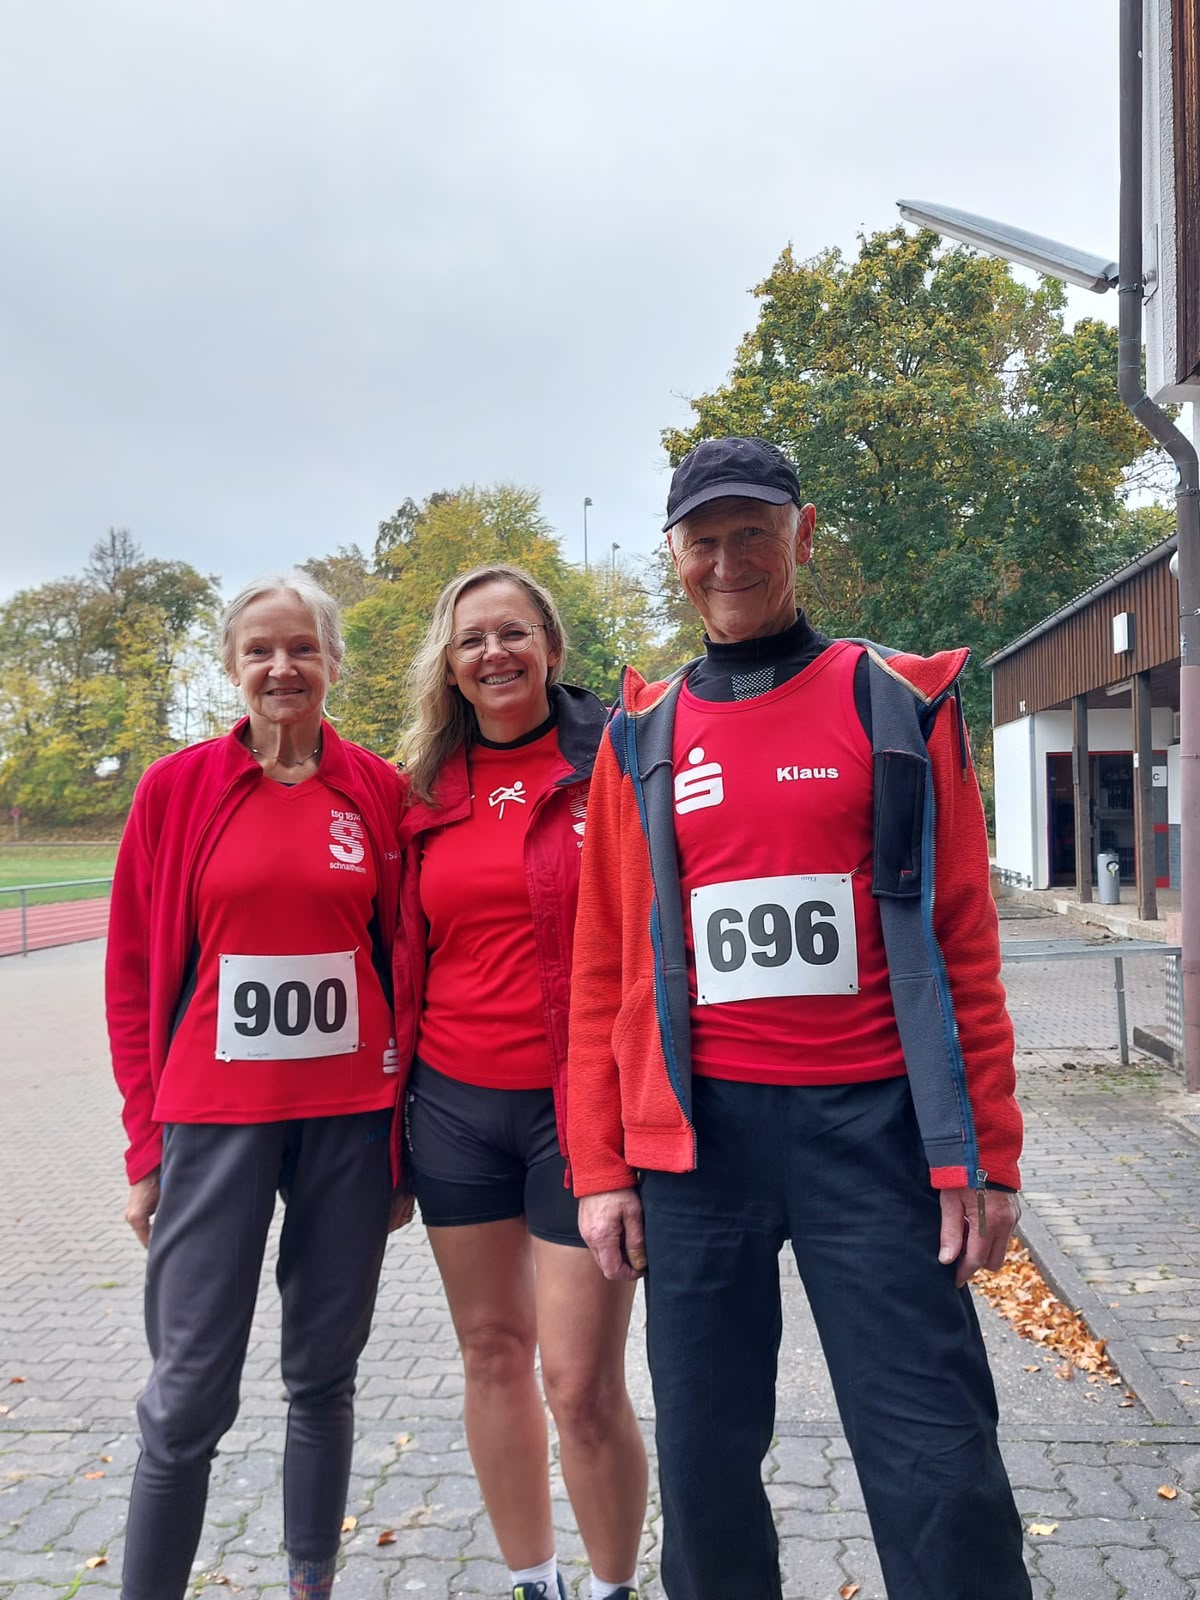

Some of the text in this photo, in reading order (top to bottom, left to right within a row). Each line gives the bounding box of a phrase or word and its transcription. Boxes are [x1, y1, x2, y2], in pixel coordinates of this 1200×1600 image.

[776, 765, 840, 782] Klaus
[1153, 773, 1160, 781] C
[331, 809, 344, 821] tsg
[706, 899, 840, 973] 696
[234, 977, 347, 1036] 900
